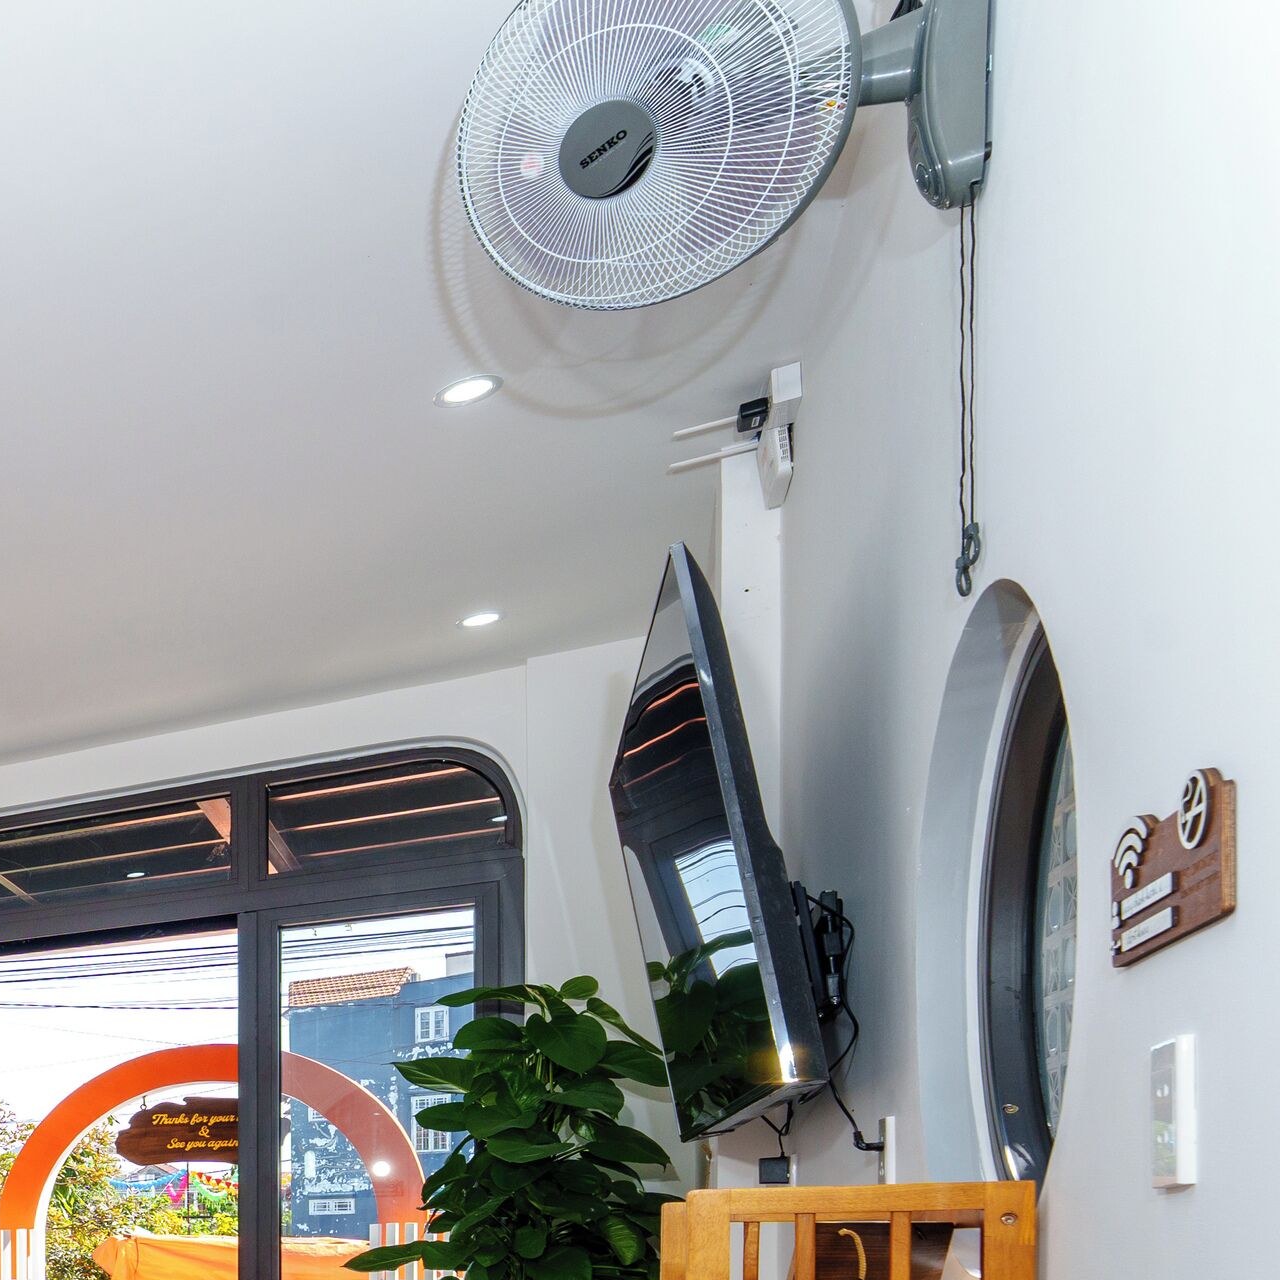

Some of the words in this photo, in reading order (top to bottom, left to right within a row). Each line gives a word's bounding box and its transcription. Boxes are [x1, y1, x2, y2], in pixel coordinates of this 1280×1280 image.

[580, 129, 627, 169] SENKO
[152, 1114, 189, 1126] Thanks
[190, 1114, 208, 1127] for
[209, 1114, 235, 1126] your
[198, 1126, 210, 1137] &
[167, 1138, 185, 1149] See
[186, 1141, 207, 1151] you
